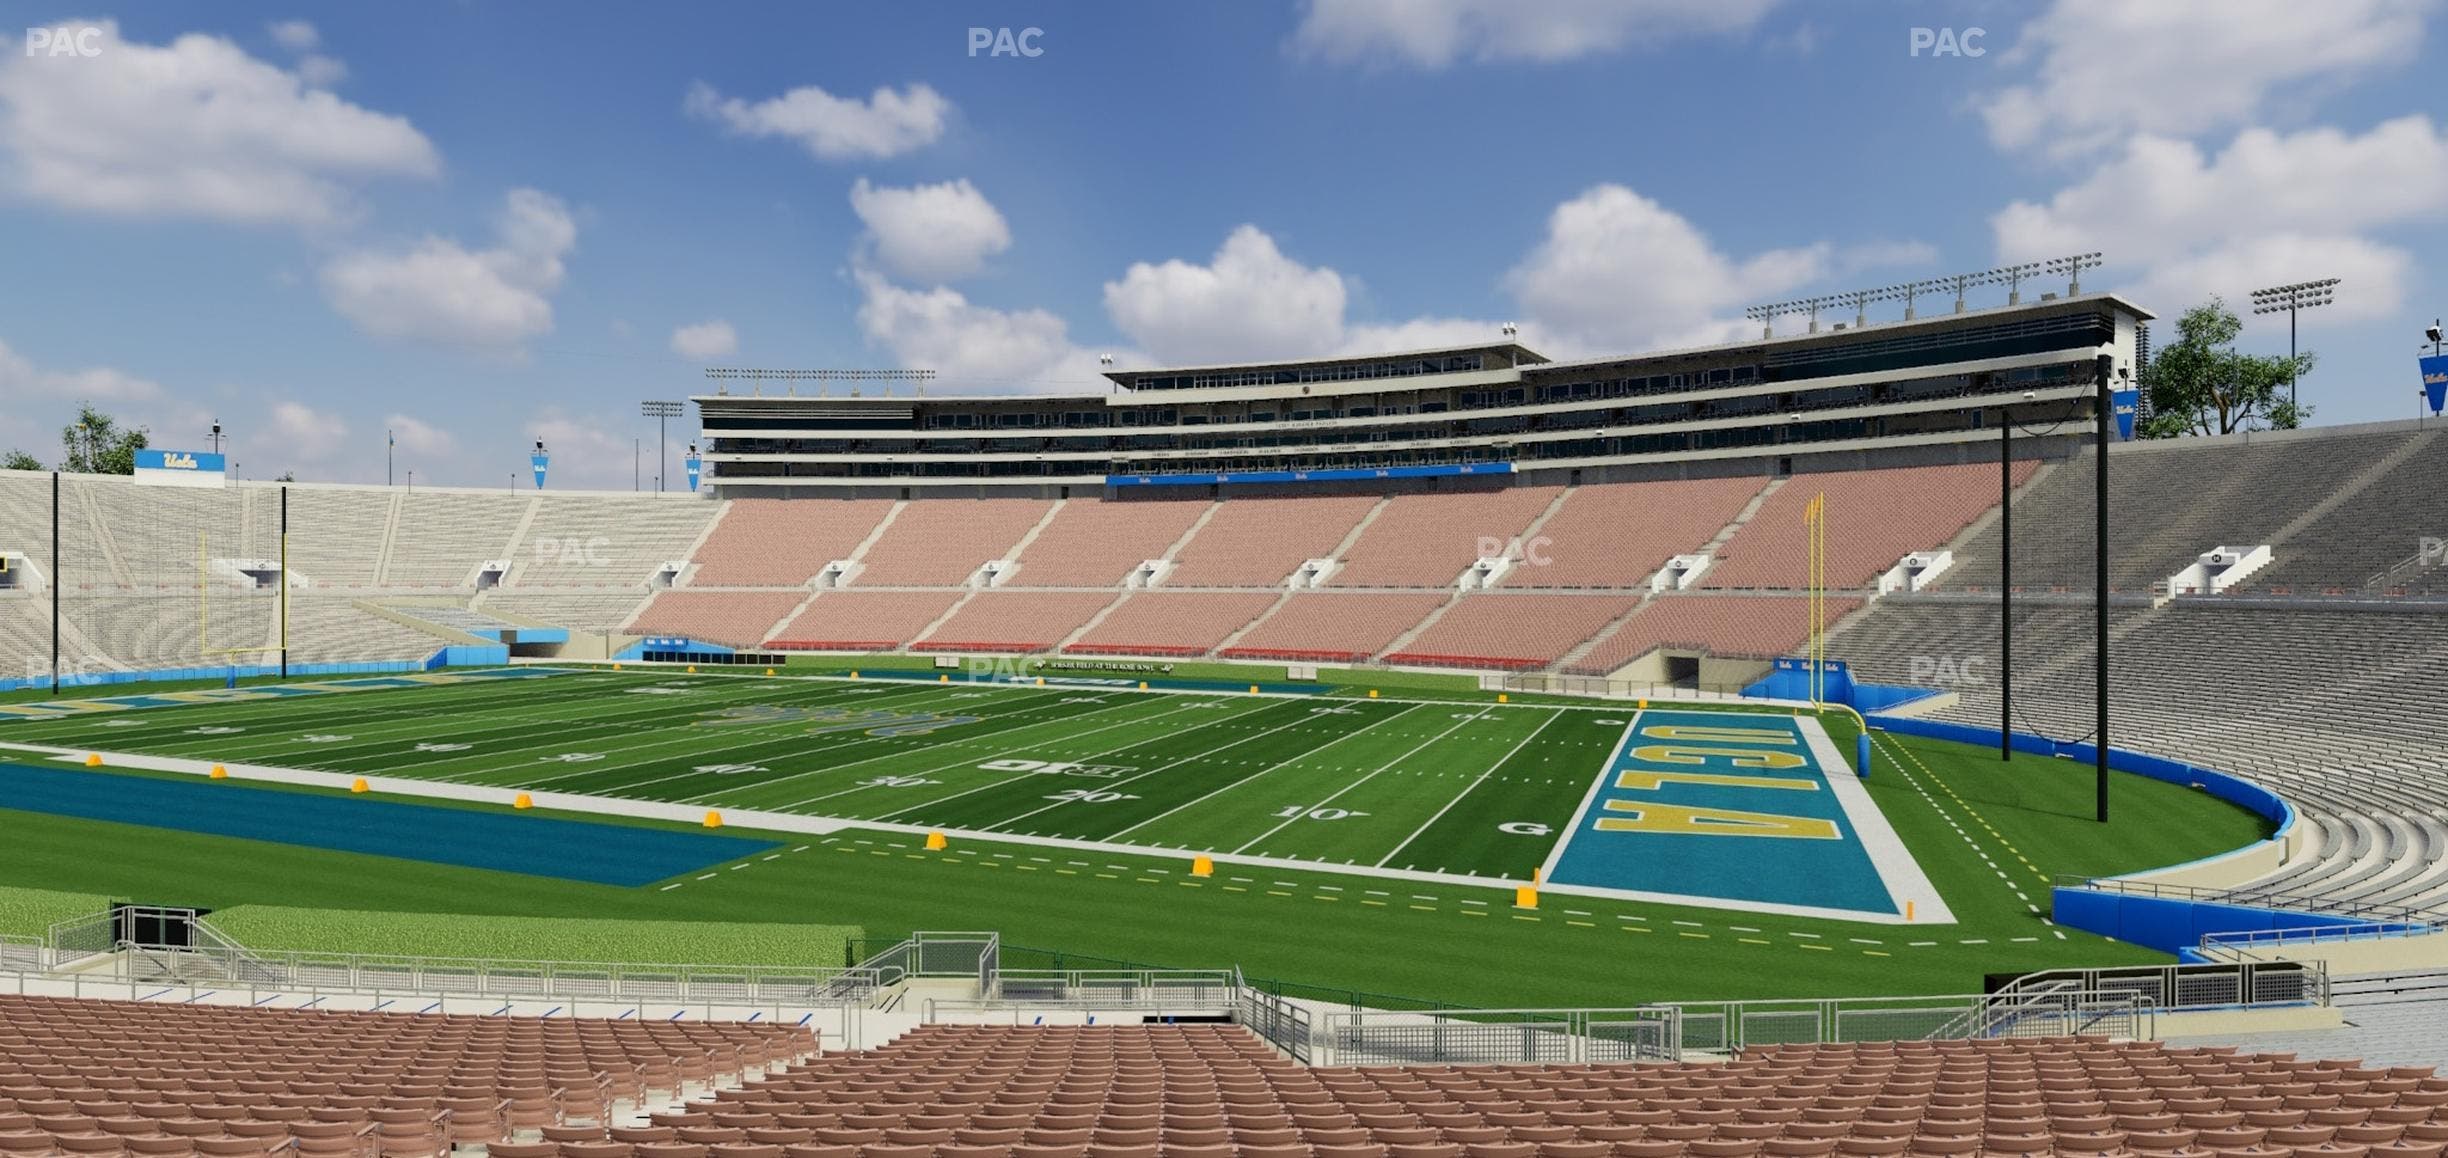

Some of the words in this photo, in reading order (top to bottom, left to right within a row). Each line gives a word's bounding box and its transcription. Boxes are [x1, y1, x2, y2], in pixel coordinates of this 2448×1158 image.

[1592, 725, 1844, 840] UCLA
[1042, 789, 1122, 802] 20
[1270, 806, 1349, 820] 10
[1498, 822, 1553, 836] G
